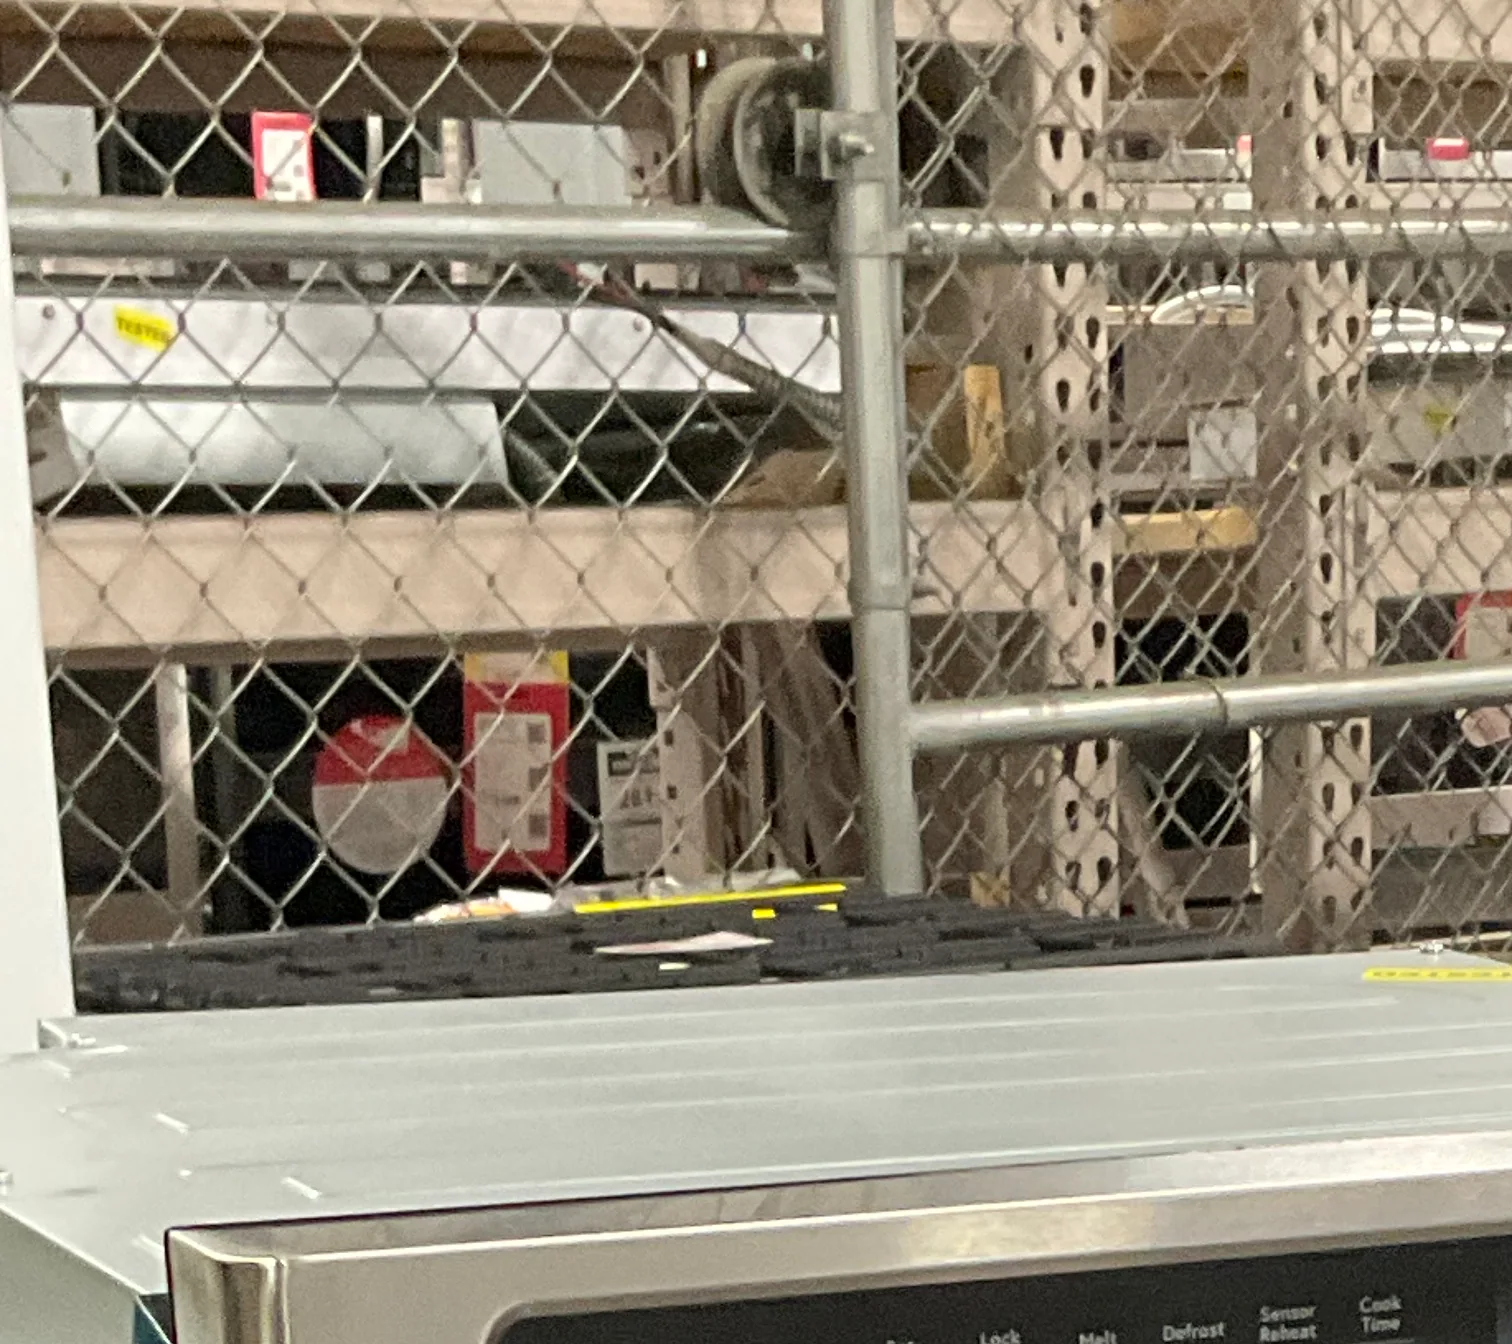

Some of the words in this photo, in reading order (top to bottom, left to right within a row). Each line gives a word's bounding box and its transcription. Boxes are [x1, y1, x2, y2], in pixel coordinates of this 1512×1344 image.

[1359, 1294, 1401, 1313] Cook
[1260, 1305, 1317, 1322] Sensor
[1162, 1321, 1225, 1343] Defrost
[1260, 1323, 1317, 1343] Reheat
[1362, 1316, 1400, 1333] Time
